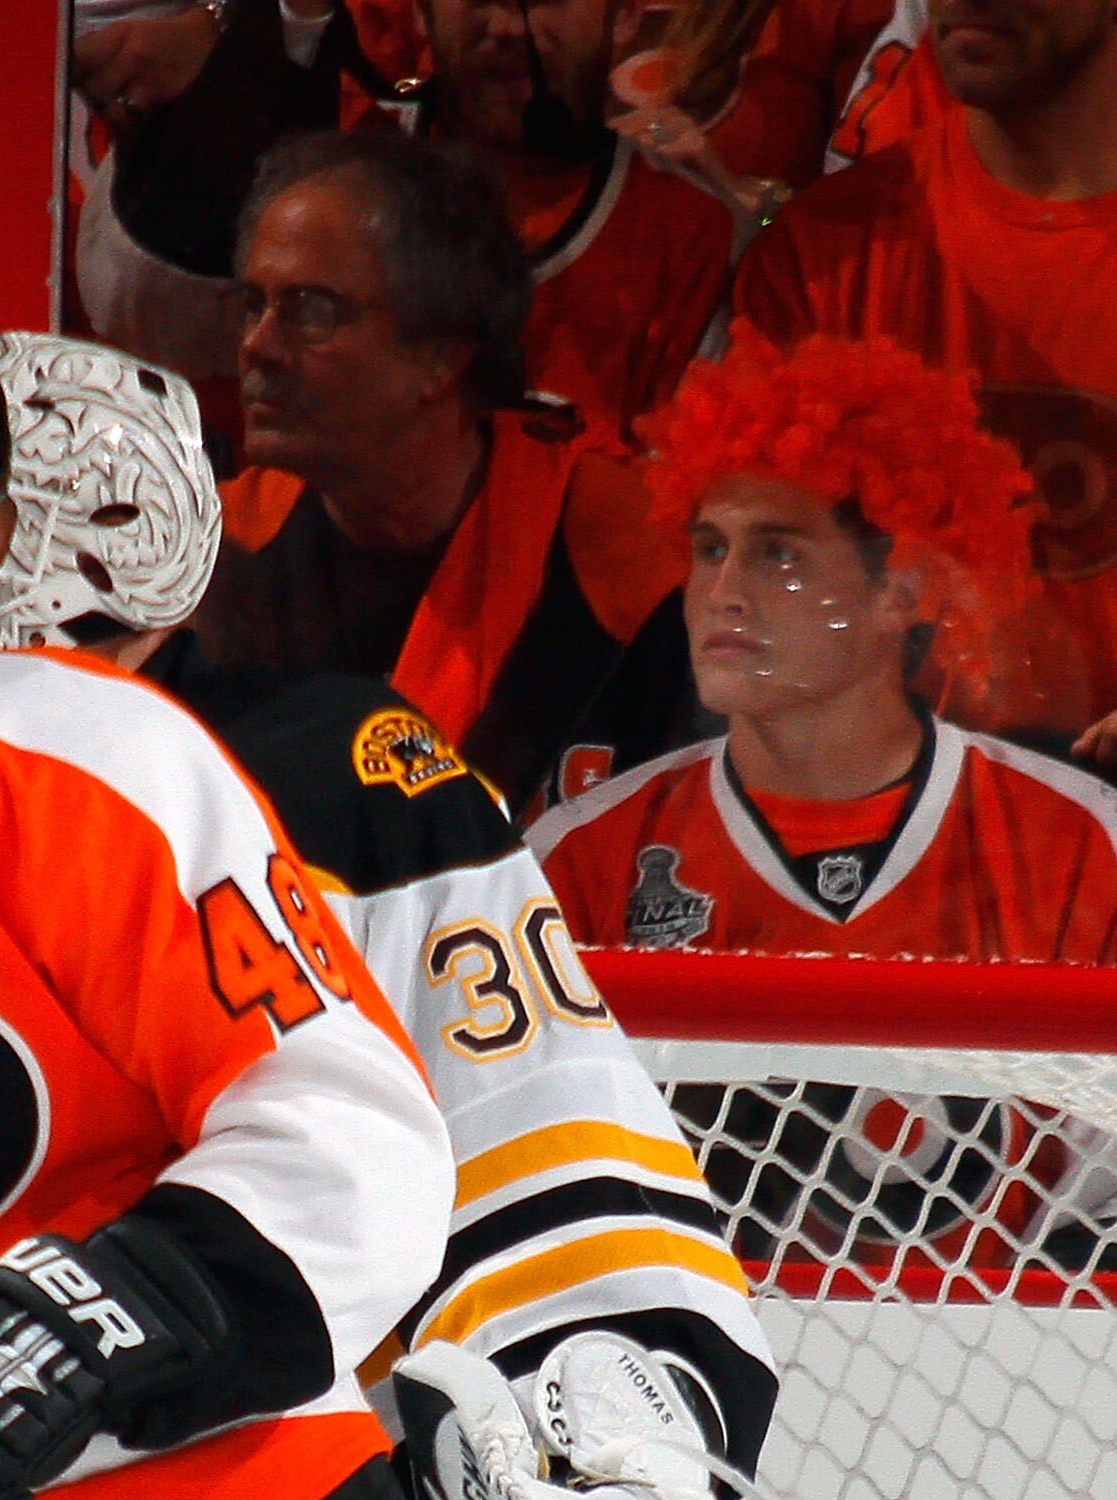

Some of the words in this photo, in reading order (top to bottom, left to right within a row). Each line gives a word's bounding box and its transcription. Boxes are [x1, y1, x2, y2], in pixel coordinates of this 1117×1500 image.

[195, 852, 354, 1036] 48
[423, 896, 616, 1065] 30
[617, 1352, 676, 1426] THOMAS
